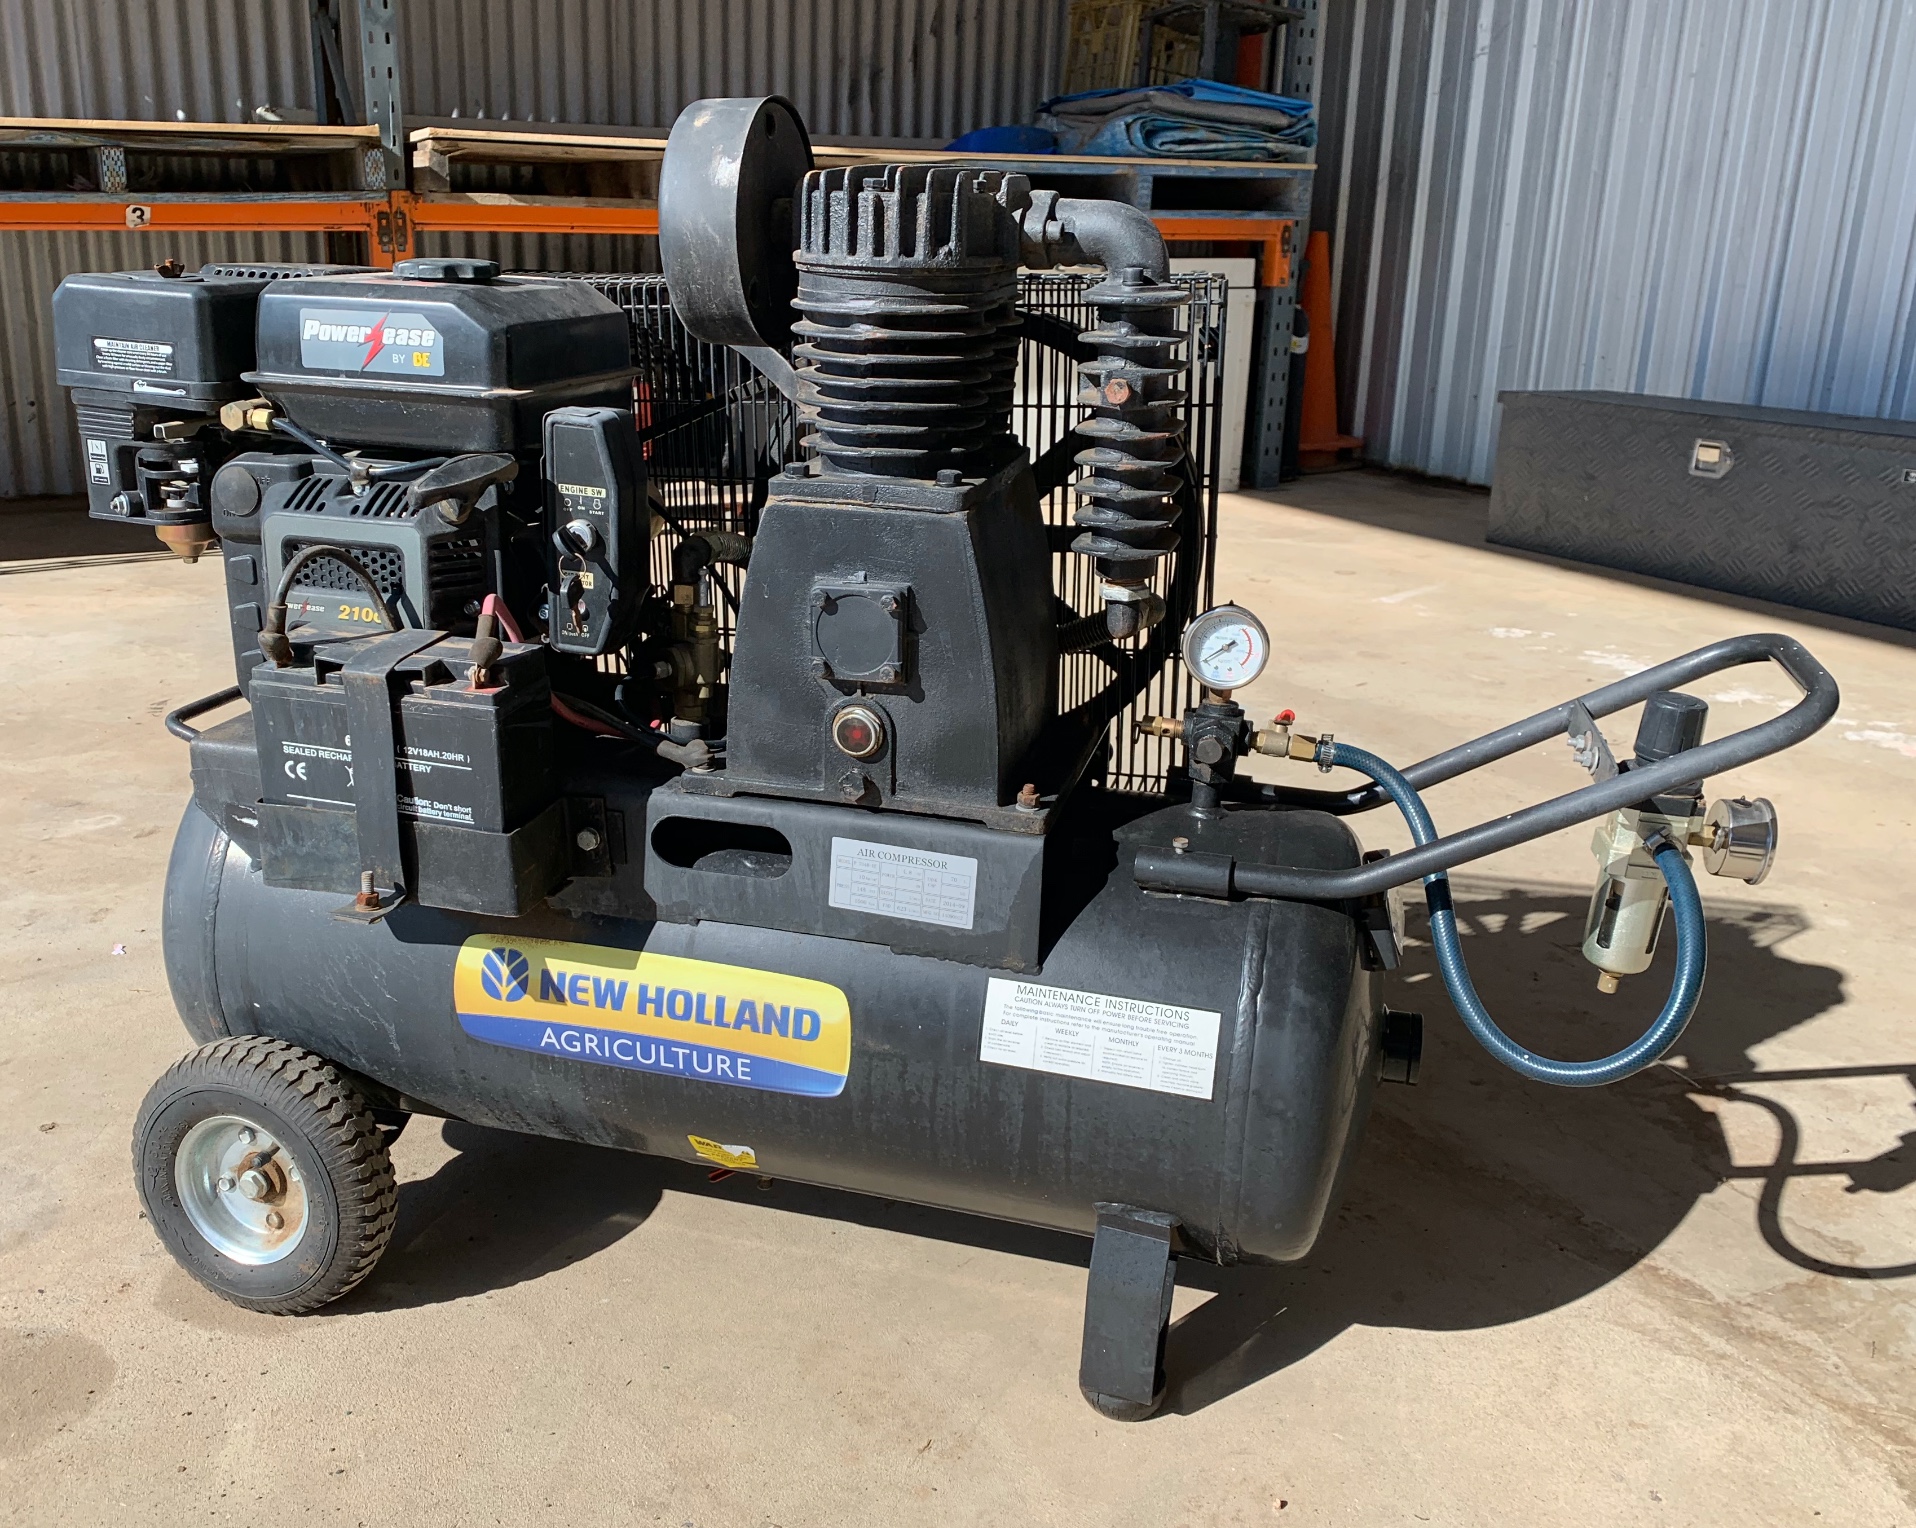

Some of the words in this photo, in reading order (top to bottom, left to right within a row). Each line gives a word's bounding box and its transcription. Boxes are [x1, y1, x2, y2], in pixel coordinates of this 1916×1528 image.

[131, 206, 145, 227] 3
[107, 341, 130, 349] MAINTAIN
[139, 344, 160, 352] CLEANER
[392, 354, 405, 364] BY
[560, 484, 589, 495] ENGINE
[591, 488, 603, 496] SW
[283, 745, 317, 757] SEALED
[395, 762, 432, 774] ATTERY
[284, 760, 307, 781] CE
[433, 801, 453, 811] Don't
[453, 805, 472, 814] short
[857, 848, 875, 859] AIR
[877, 851, 948, 870] COMPRESSOR
[539, 968, 629, 1012] NEW
[636, 982, 822, 1042] HOLLAND
[1014, 996, 1043, 1006] CAUTION
[1044, 1001, 1068, 1010] ALWAYS
[1070, 1005, 1086, 1013] TURN
[1087, 1007, 1100, 1015] OFF
[1102, 1010, 1126, 1020] POWER
[1127, 1014, 1152, 1024] BEFORE
[1154, 1018, 1190, 1030] SERVICING
[1016, 985, 1101, 1007] MAINTENANCE
[1105, 998, 1190, 1021] INSTRUCTIONS
[1001, 1018, 1019, 1027] DAILY
[1012, 1012, 1038, 1021] complete
[1039, 1016, 1070, 1026] instructions
[1144, 1033, 1172, 1043] operating
[1015, 1005, 1038, 1014] following
[1056, 1012, 1092, 1022] maintenance
[1122, 1022, 1134, 1030] long
[1135, 1025, 1155, 1033] trouble
[1055, 1027, 1079, 1037] WEEKLY
[1108, 1037, 1139, 1047] MONTHLY
[540, 1027, 752, 1081] AGRICULTURE
[1157, 1044, 1178, 1054] EVERY
[1183, 1049, 1214, 1060] MONTHS
